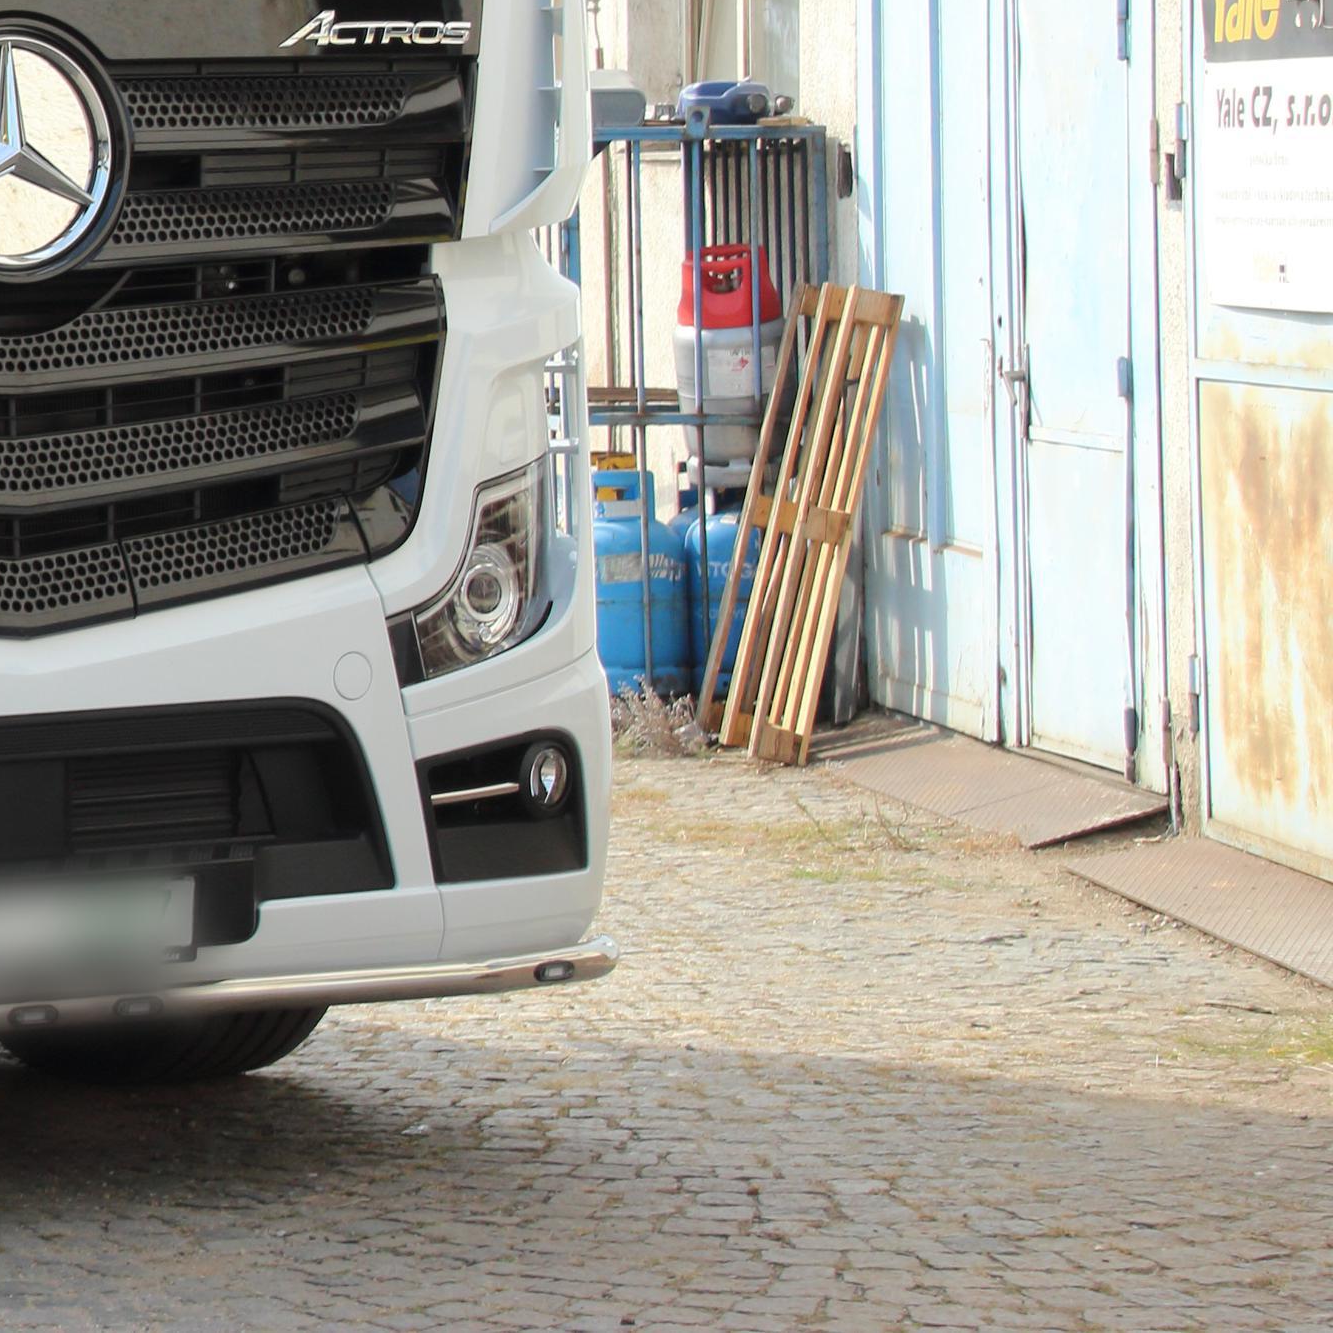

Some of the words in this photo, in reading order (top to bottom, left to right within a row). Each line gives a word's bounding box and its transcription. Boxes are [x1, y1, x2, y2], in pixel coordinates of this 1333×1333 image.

[1216, 87, 1245, 129] Yale
[1250, 85, 1278, 135] CZ,
[1286, 93, 1333, 128] s.r.o
